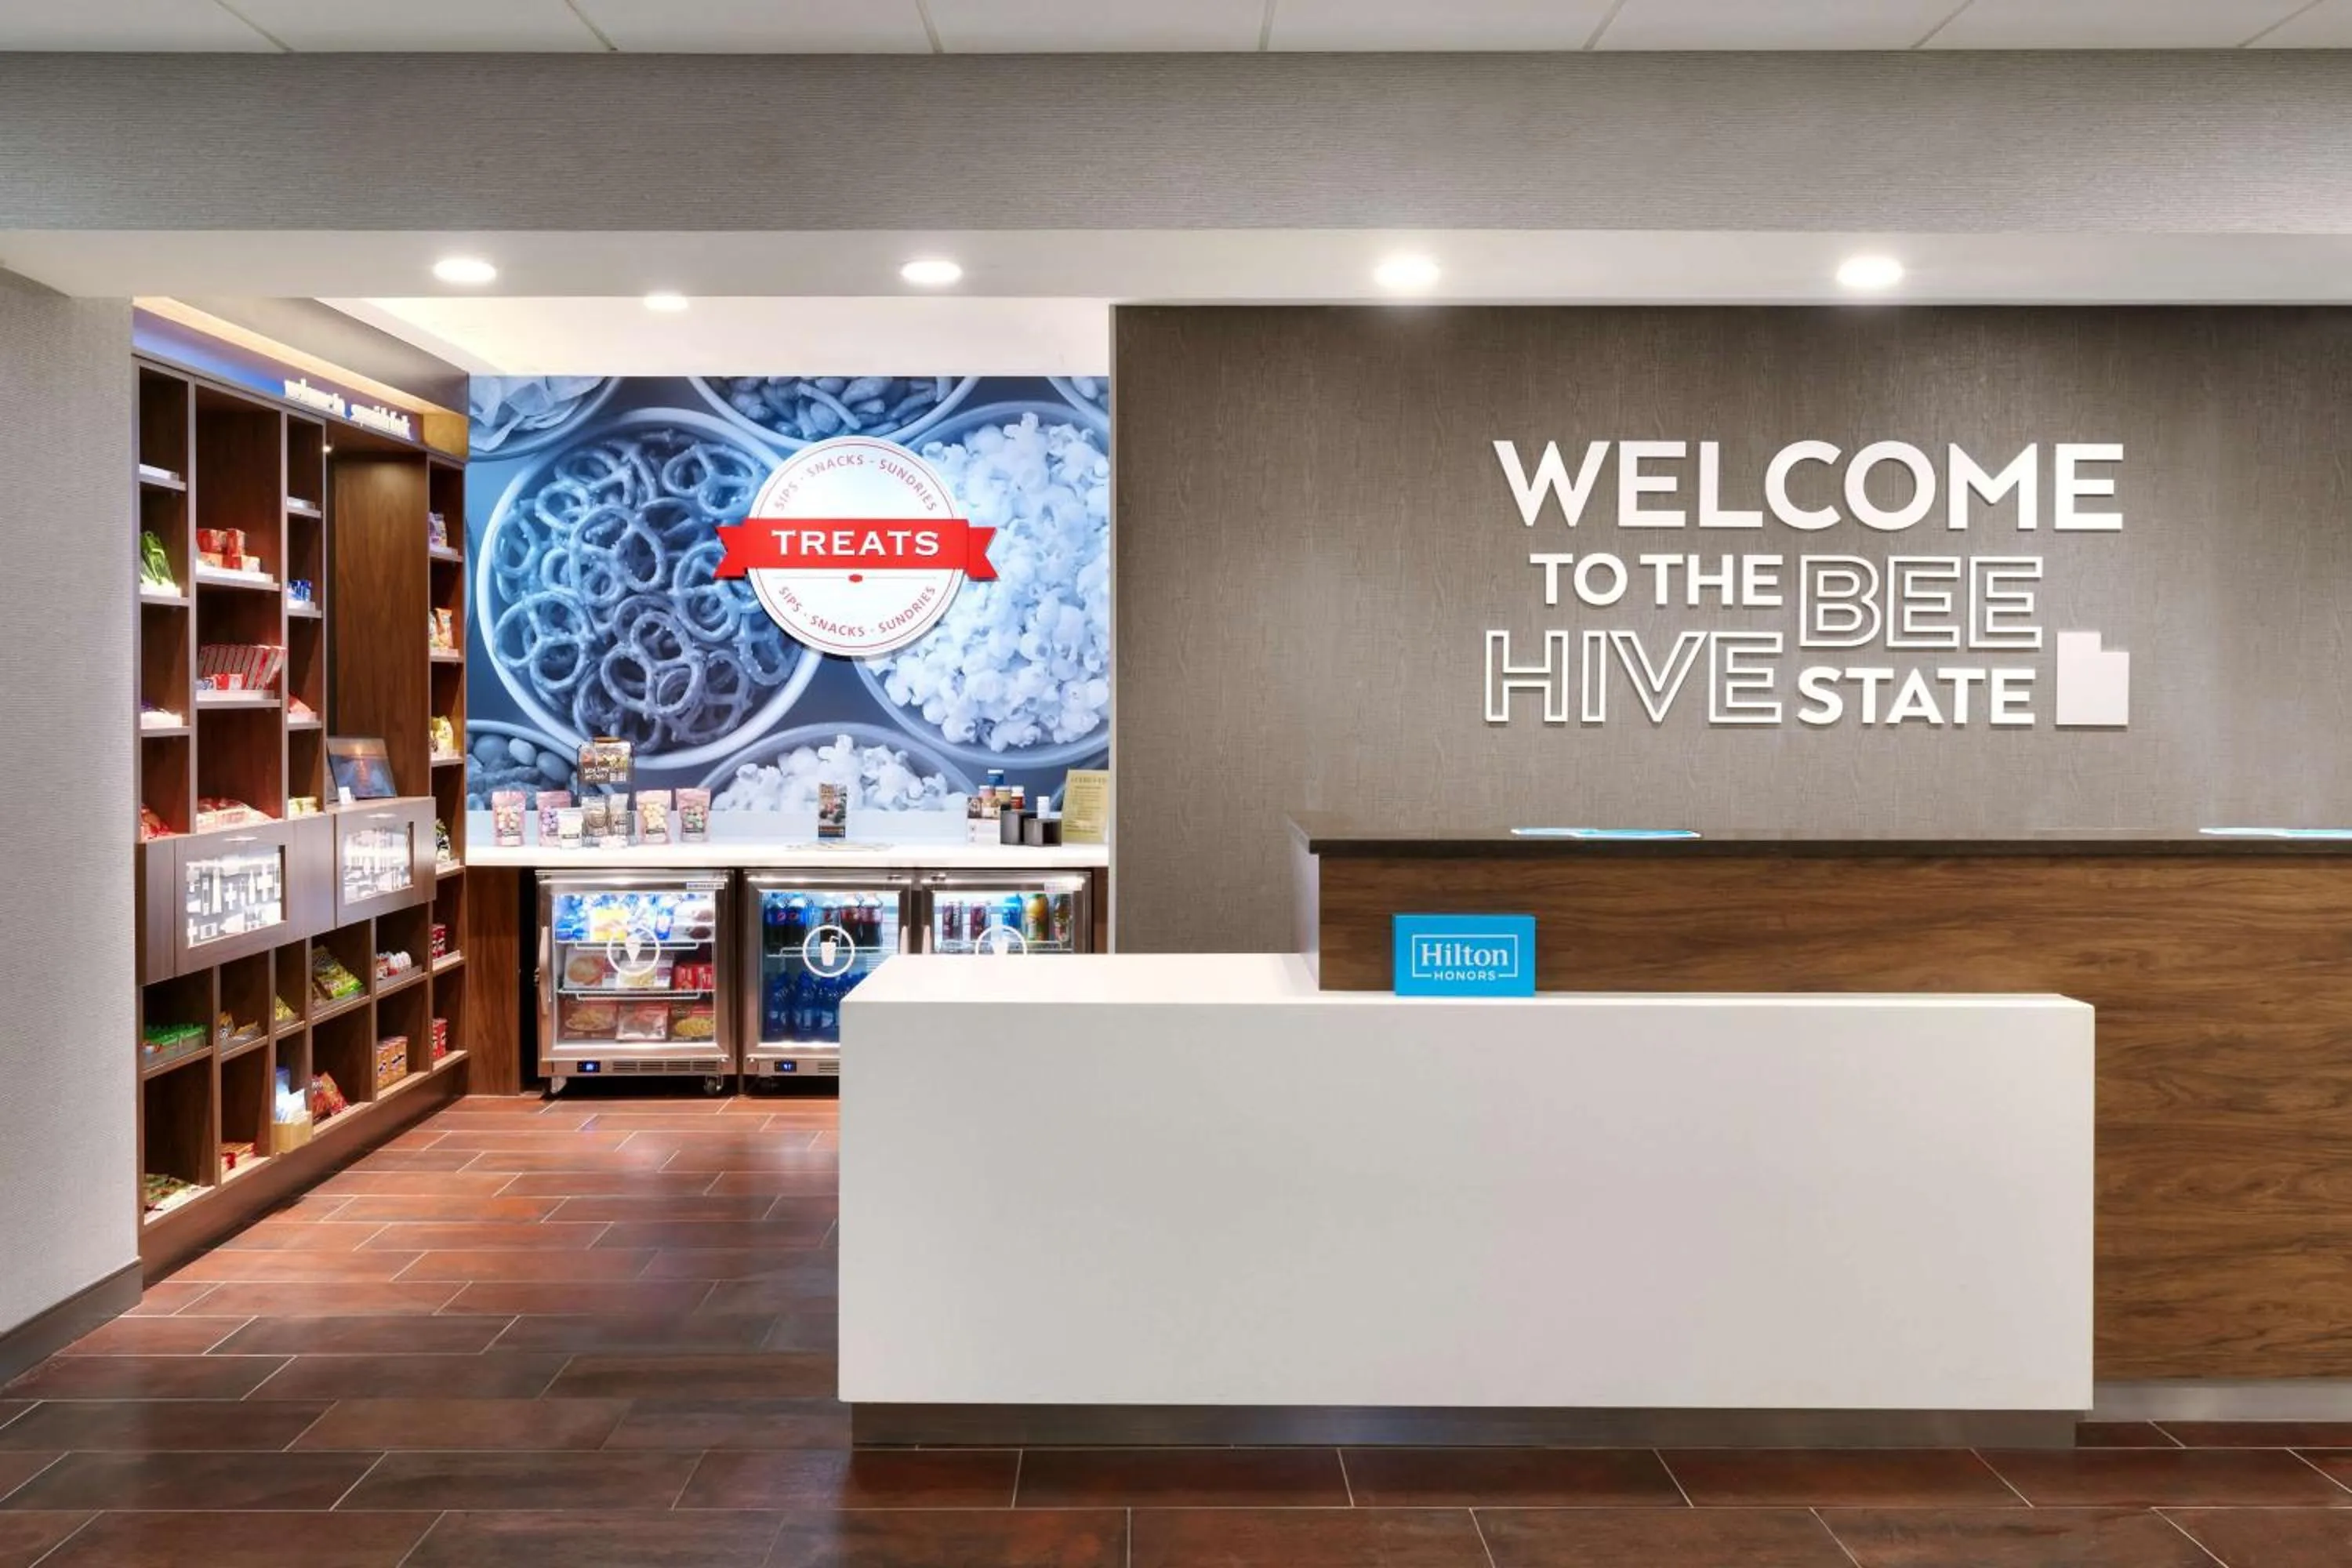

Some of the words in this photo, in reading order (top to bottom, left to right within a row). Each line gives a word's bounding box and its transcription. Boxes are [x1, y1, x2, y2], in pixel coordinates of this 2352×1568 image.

[774, 481, 799, 510] SIPS
[807, 454, 864, 477] SNACKS
[878, 459, 937, 511] SUNDRIES
[1493, 440, 2124, 531] WELCOME
[771, 530, 939, 556] TREATS
[778, 586, 803, 614] SIPS
[810, 615, 866, 637] SNACKS
[878, 585, 935, 633] SUNDRIES
[1530, 553, 1628, 606] TO
[1641, 554, 1784, 606] THE
[1799, 554, 2044, 648] BEE
[1485, 630, 1784, 724] HIVE
[1797, 667, 2036, 724] STATE
[1421, 943, 1508, 966] Hilton
[1434, 971, 1496, 981] HONORS
